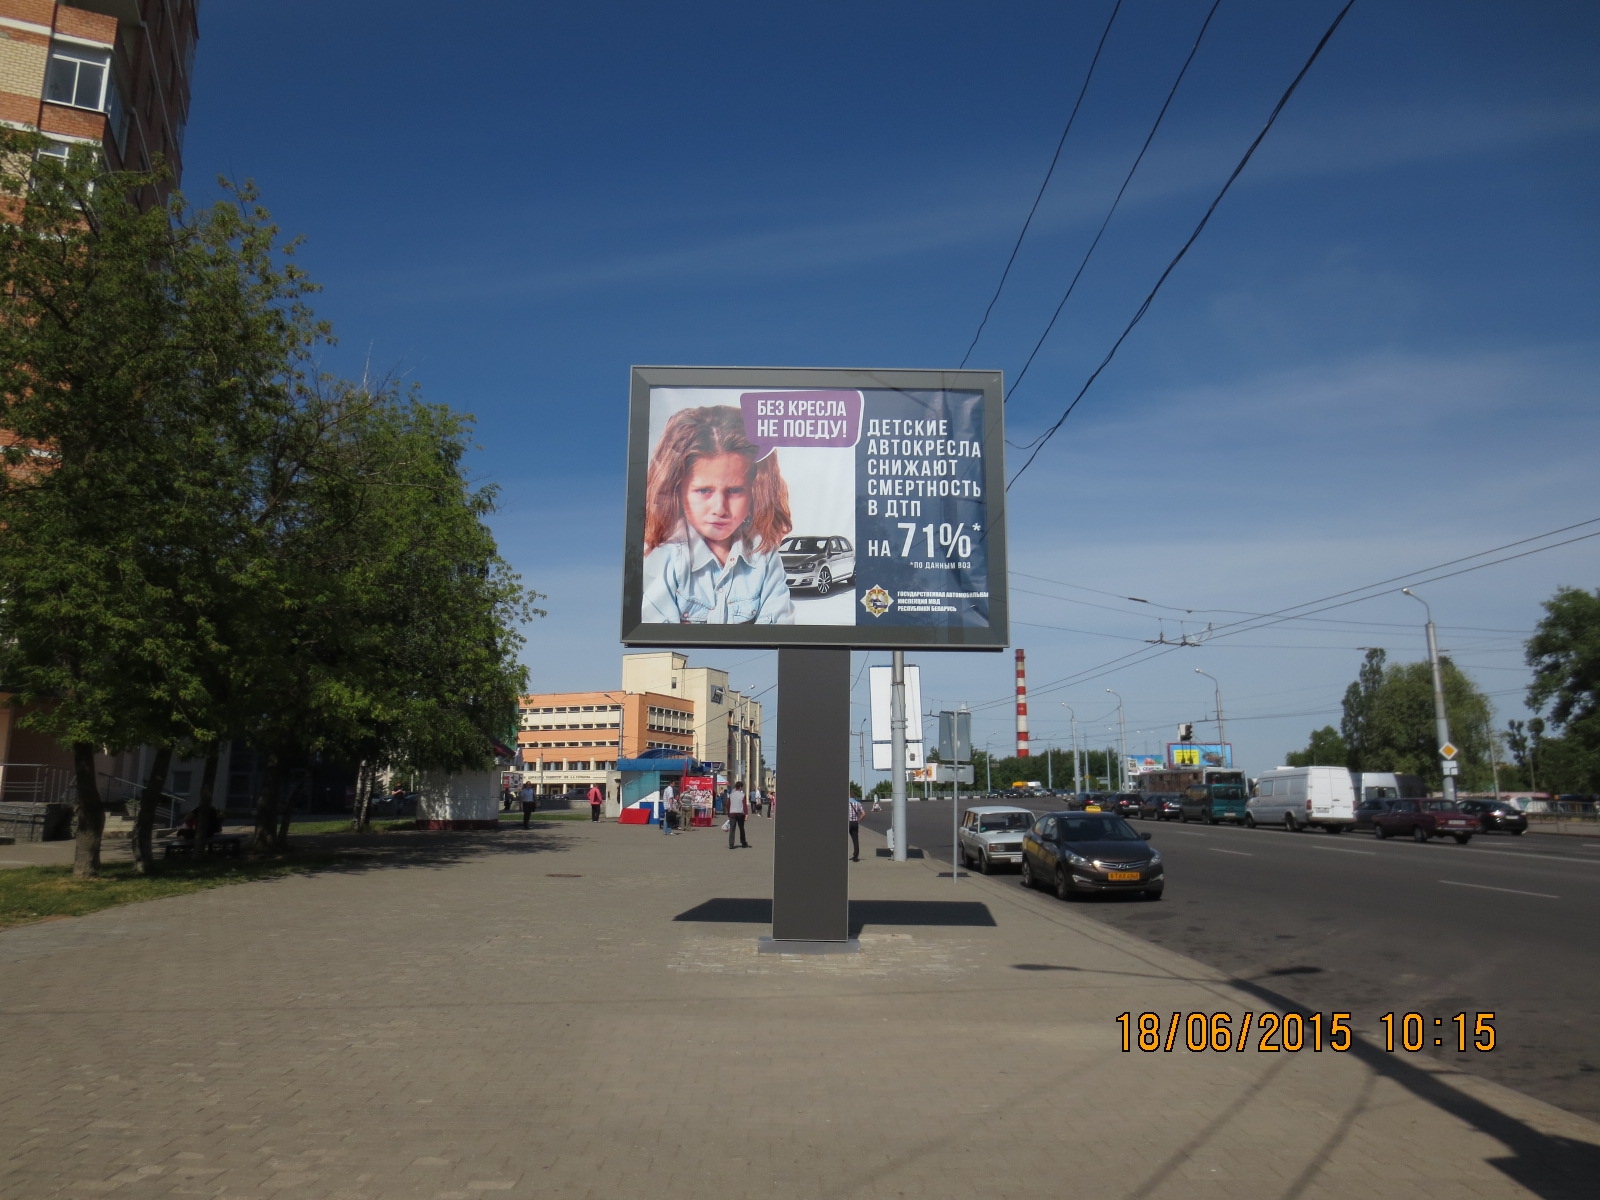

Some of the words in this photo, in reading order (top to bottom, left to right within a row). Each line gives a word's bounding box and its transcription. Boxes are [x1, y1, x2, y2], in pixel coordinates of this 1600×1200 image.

[757, 400, 784, 416] БЕЗ
[788, 400, 847, 417] КРЕСЛА
[757, 419, 778, 437] НЕ
[783, 420, 847, 440] ПОЕДУ!
[867, 419, 948, 436] ДЕТСКИЕ
[867, 439, 981, 458] АВТОКРЕСЛА
[867, 459, 958, 477] СНИЖАЮТ
[867, 479, 981, 497] СМЕРТНОСТЬ
[867, 500, 878, 516] В
[885, 500, 921, 518] ДТП
[868, 539, 891, 557] НА
[925, 561, 956, 570] ДАННЫМ
[957, 561, 971, 569] ВОЗ
